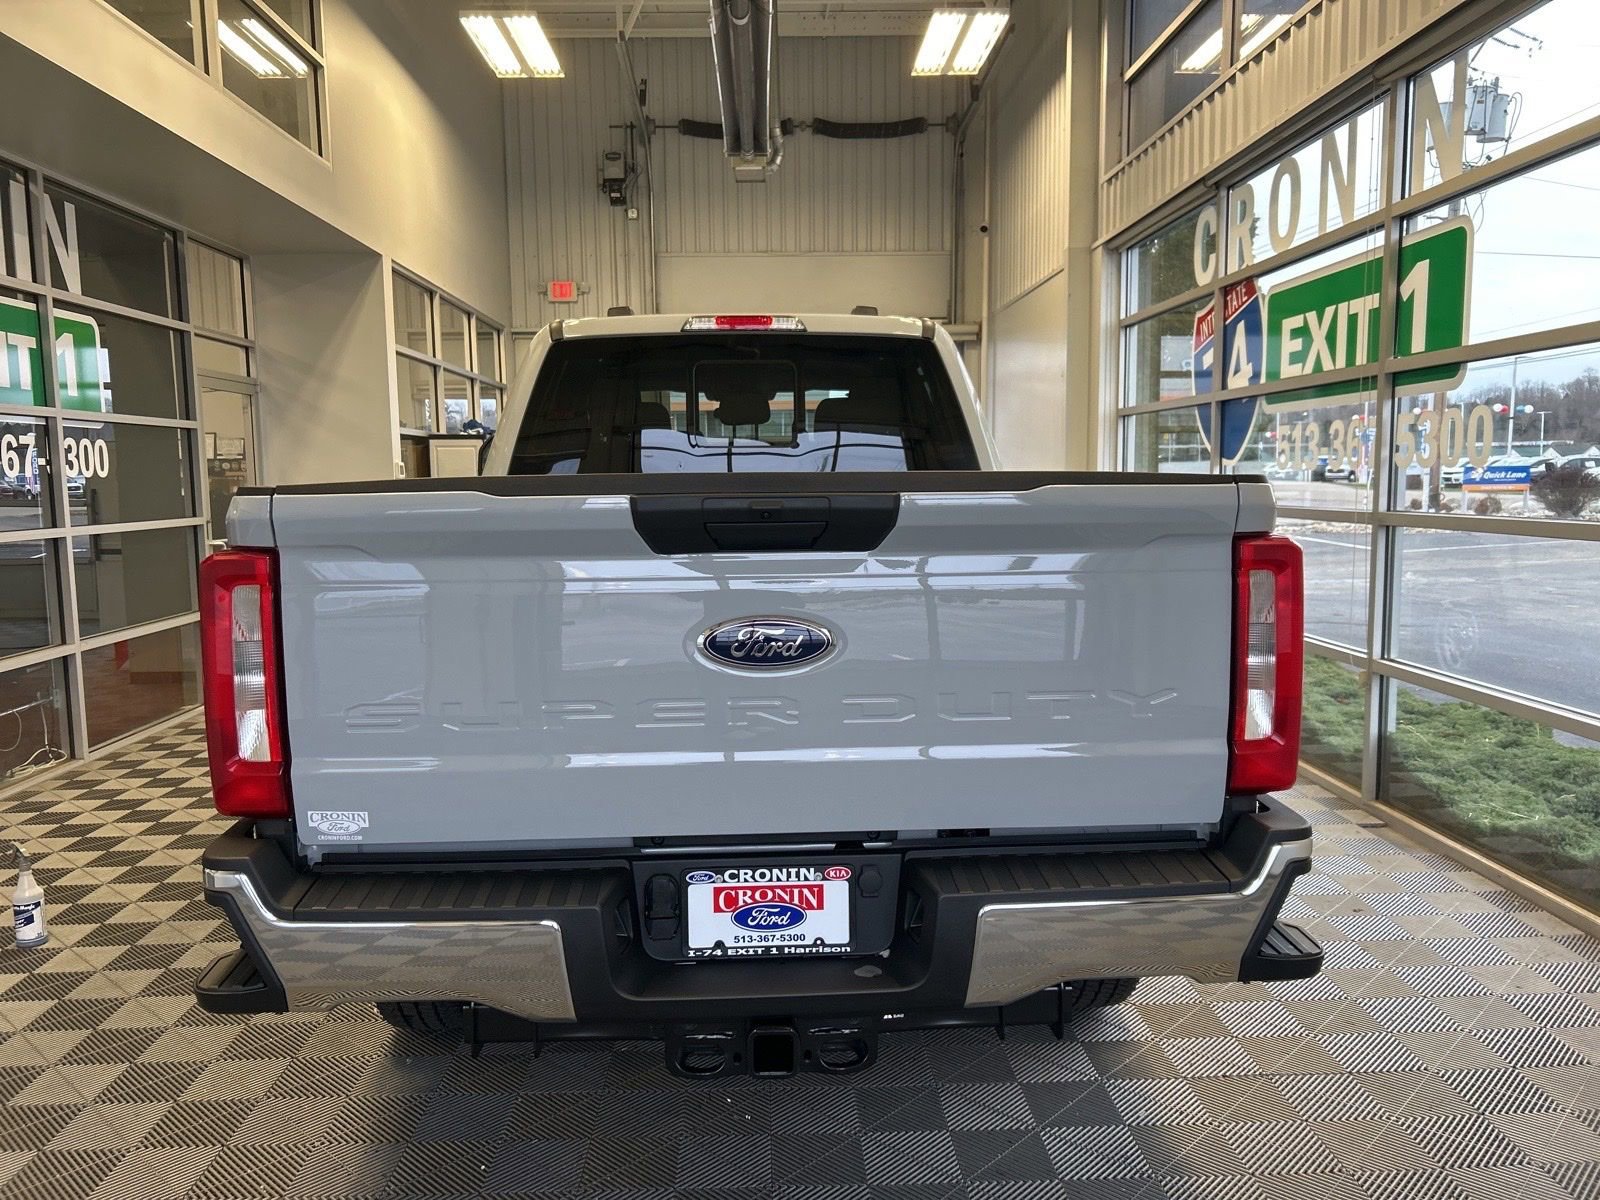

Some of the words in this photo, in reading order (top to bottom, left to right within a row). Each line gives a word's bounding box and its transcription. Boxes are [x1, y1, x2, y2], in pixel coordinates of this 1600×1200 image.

[1279, 292, 1381, 379] EXIT
[1400, 259, 1430, 354] 1
[1483, 471, 1505, 480] Quick
[1507, 471, 1527, 479] Lane
[730, 627, 804, 658] Ford
[342, 697, 800, 733] SUPER
[841, 687, 1179, 724] DUTY
[309, 812, 367, 825] CRONIN
[327, 822, 351, 832] Ford
[692, 873, 709, 882] Ford
[723, 867, 815, 883] CRONIN
[829, 869, 847, 878] KIA
[718, 887, 819, 912] CRONIN
[747, 907, 791, 926] Ford
[733, 933, 806, 944] 513-367-5300
[687, 949, 723, 957] I-74
[727, 948, 766, 956] EXIT
[784, 946, 851, 954] Harrison
